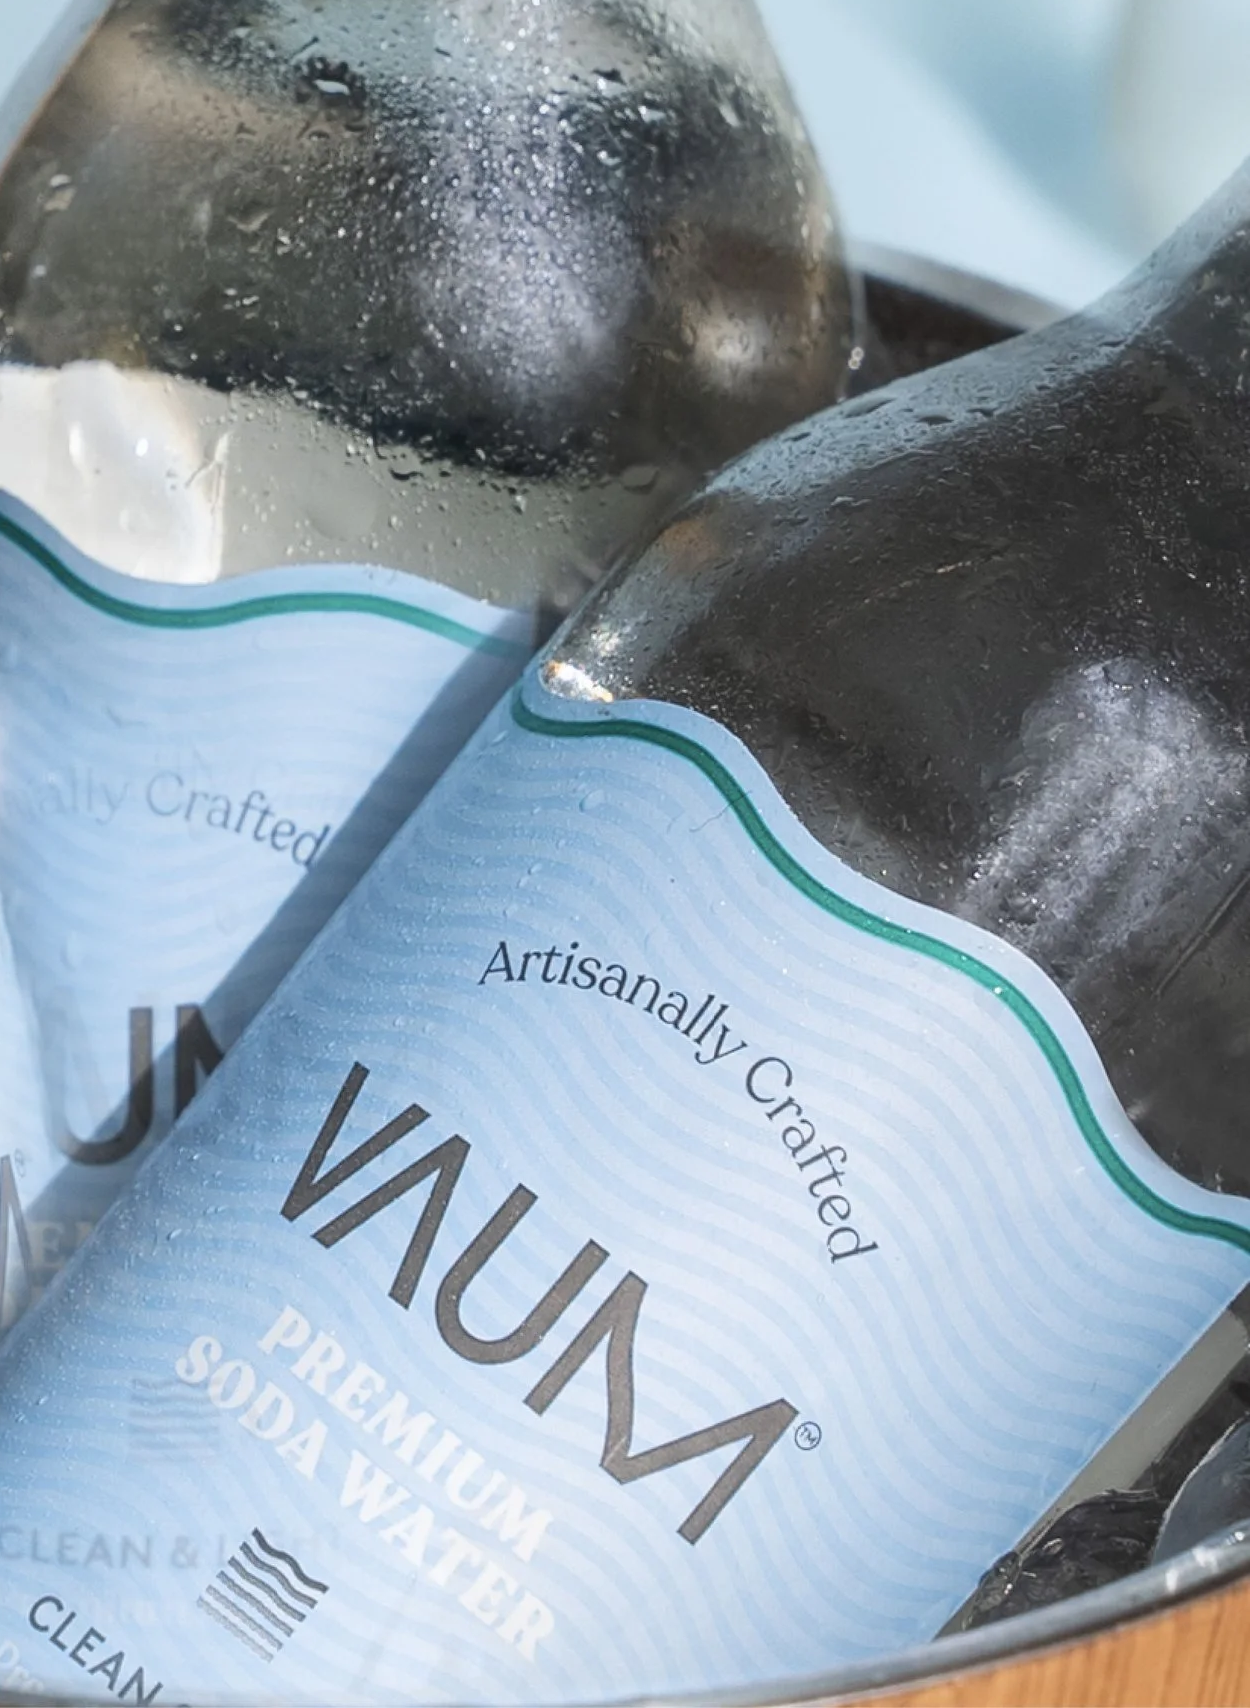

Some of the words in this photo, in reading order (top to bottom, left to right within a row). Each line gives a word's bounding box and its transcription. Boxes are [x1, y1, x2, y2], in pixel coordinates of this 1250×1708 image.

[145, 770, 332, 872] Crafted
[478, 941, 748, 1065] Artisanally
[745, 1055, 880, 1264] Crafted
[257, 1304, 556, 1563] PREMIUM
[280, 1060, 799, 1546] VAUM
[174, 1335, 329, 1481] SODA
[338, 1449, 556, 1663] WATER
[27, 1594, 164, 1704] CLEAN
